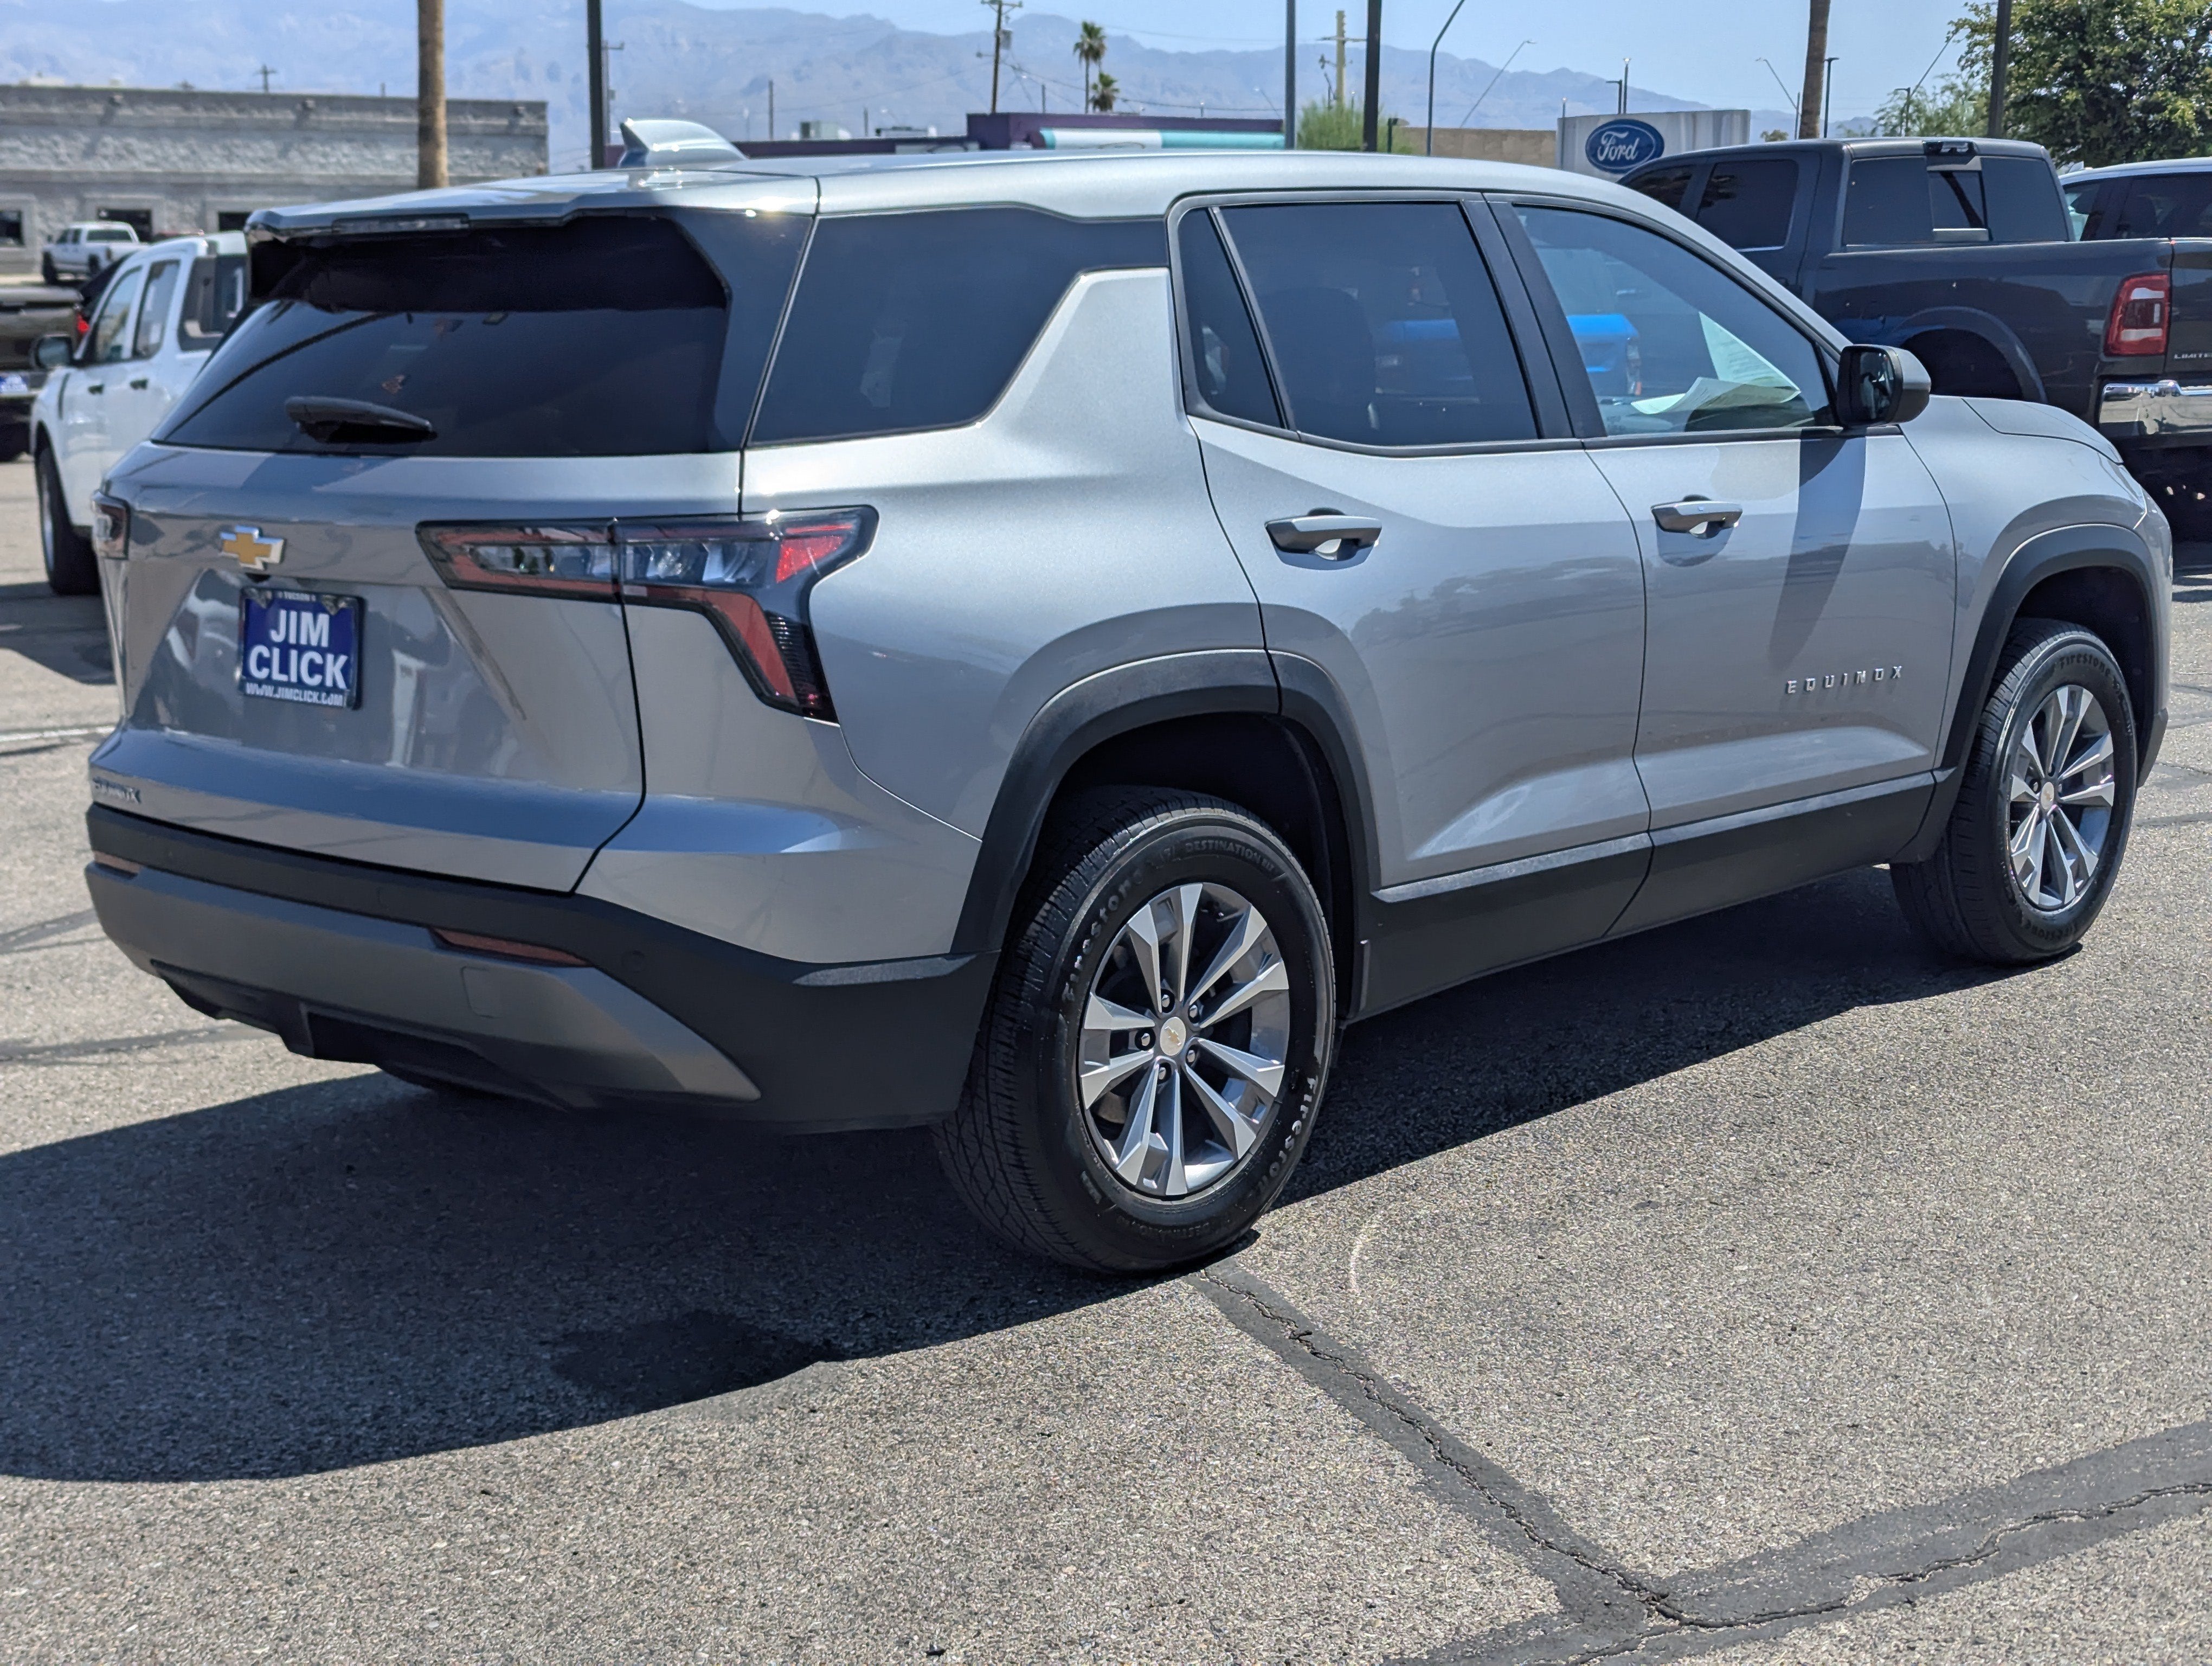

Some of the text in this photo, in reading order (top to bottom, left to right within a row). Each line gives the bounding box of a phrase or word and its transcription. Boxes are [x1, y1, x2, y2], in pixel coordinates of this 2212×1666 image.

[1597, 131, 1640, 161] Ford
[270, 609, 330, 647] JIM
[249, 644, 348, 689] CLICK
[2060, 653, 2111, 676] Firestone
[1787, 665, 1902, 694] EQUINOX
[1185, 840, 1262, 866] DESTINATION
